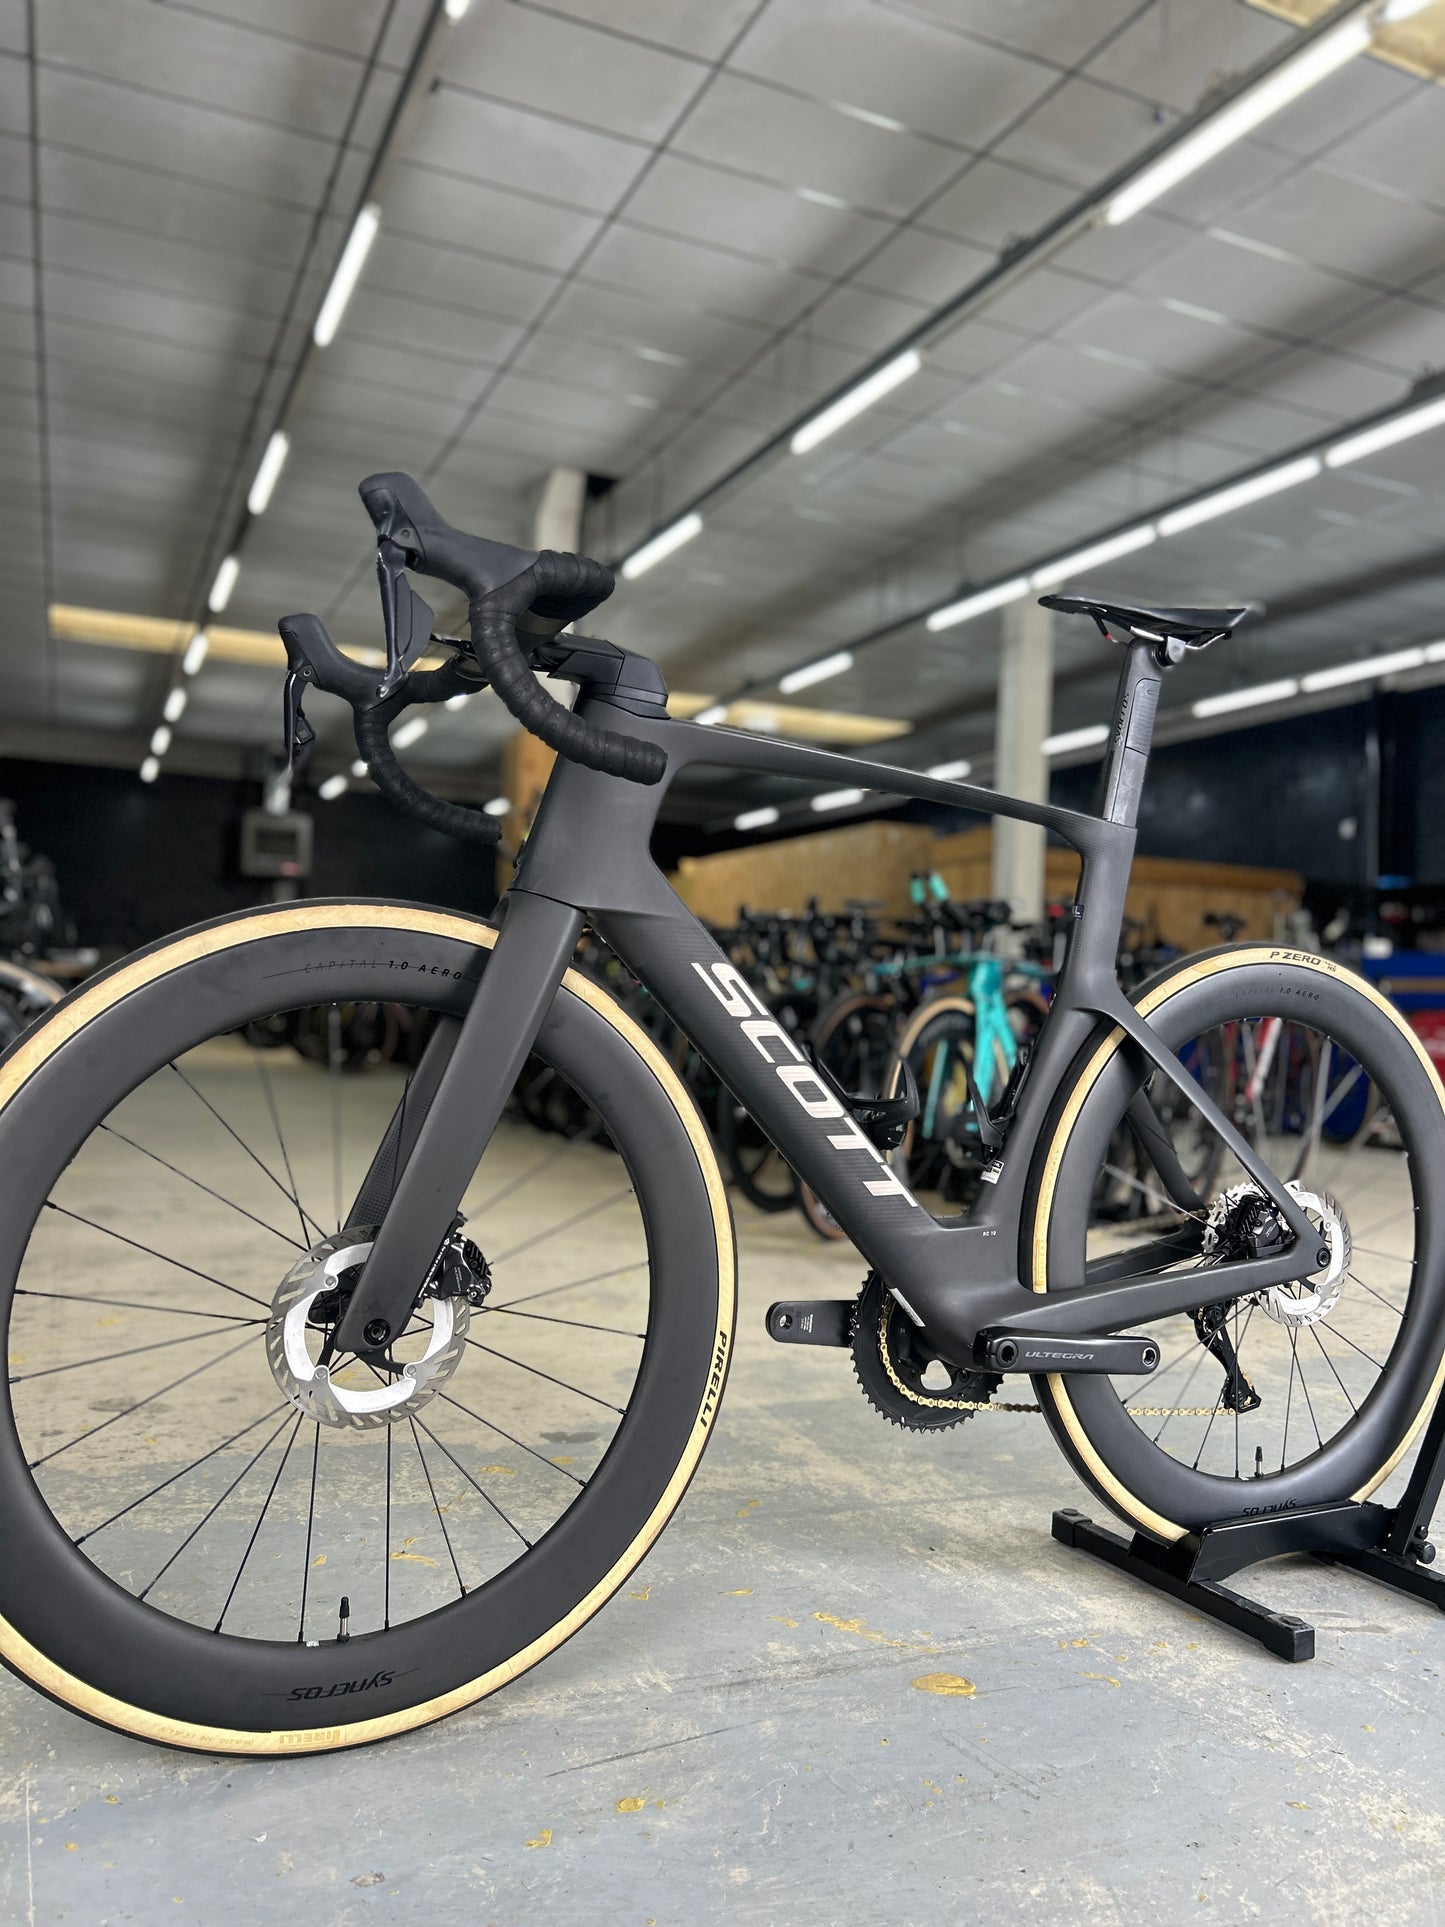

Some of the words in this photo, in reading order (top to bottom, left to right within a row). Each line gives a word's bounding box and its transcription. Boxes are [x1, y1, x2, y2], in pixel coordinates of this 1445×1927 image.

[1269, 951, 1280, 959] P
[1281, 951, 1322, 966] ZERO
[303, 959, 377, 974] CAPITAL
[386, 960, 410, 971] 1.0
[417, 963, 463, 981] AERO
[1295, 988, 1320, 1001] AERO
[690, 961, 919, 1208] SCOTT
[1024, 1351, 1095, 1360] ULTEGRA
[699, 1330, 728, 1428] PIRELLI
[279, 1730, 340, 1745] PIRELLI
